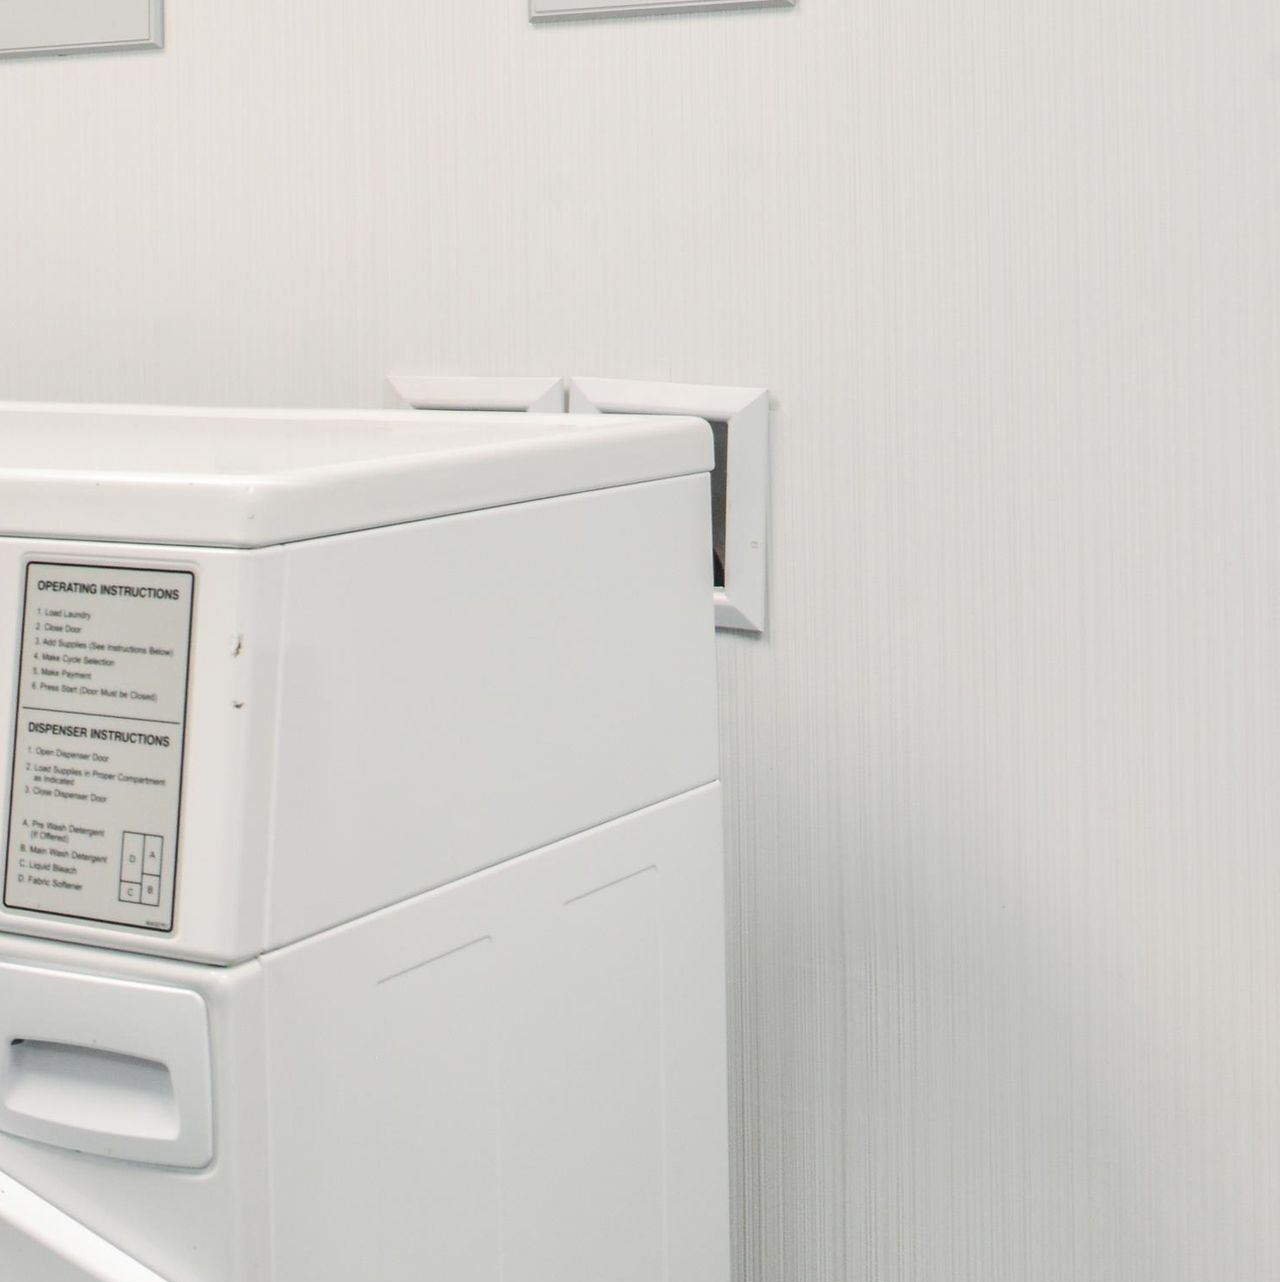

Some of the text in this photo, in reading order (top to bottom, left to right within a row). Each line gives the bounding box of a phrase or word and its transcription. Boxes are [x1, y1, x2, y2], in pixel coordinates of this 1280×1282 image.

[38, 580, 179, 600] OPERATING INSTRUCTIONS
[45, 609, 62, 617] Load
[64, 610, 91, 620] Laundry
[44, 623, 63, 633] Close
[65, 625, 81, 633] Door
[43, 638, 56, 647] Add
[59, 640, 86, 650] Supplies
[107, 643, 146, 654] Instructions
[42, 653, 60, 662] Make
[62, 655, 81, 665] Cycle
[84, 657, 114, 666] Selection
[41, 668, 59, 677] Make
[62, 669, 91, 680] Payment
[40, 682, 59, 692] Press
[61, 684, 77, 693] Start
[80, 685, 99, 696] (Door
[101, 687, 117, 697] Must
[119, 689, 127, 697] be
[29, 722, 170, 747] DISPENSER INSTRUCTIONS
[36, 746, 53, 757] Open
[56, 749, 90, 760] Dispenser
[92, 753, 109, 762] Door
[34, 764, 51, 773] Load
[54, 766, 82, 776] Supplies
[92, 771, 115, 781] Proper
[118, 774, 165, 785] Compartment
[44, 775, 74, 785] Indicated
[33, 787, 52, 795] Close
[54, 790, 88, 801] Dispenser
[90, 793, 107, 803] Door
[32, 820, 44, 829] Pre
[47, 822, 67, 832] Wash
[69, 824, 104, 836] Detergent
[30, 846, 46, 855] Main
[49, 848, 69, 858] Wash
[72, 851, 107, 863] Detergent
[130, 855, 135, 863] D
[29, 861, 50, 871] Liquid
[52, 864, 77, 874] Bleach
[28, 876, 50, 887] Fabric
[52, 879, 83, 891] Softener
[127, 888, 133, 896] C
